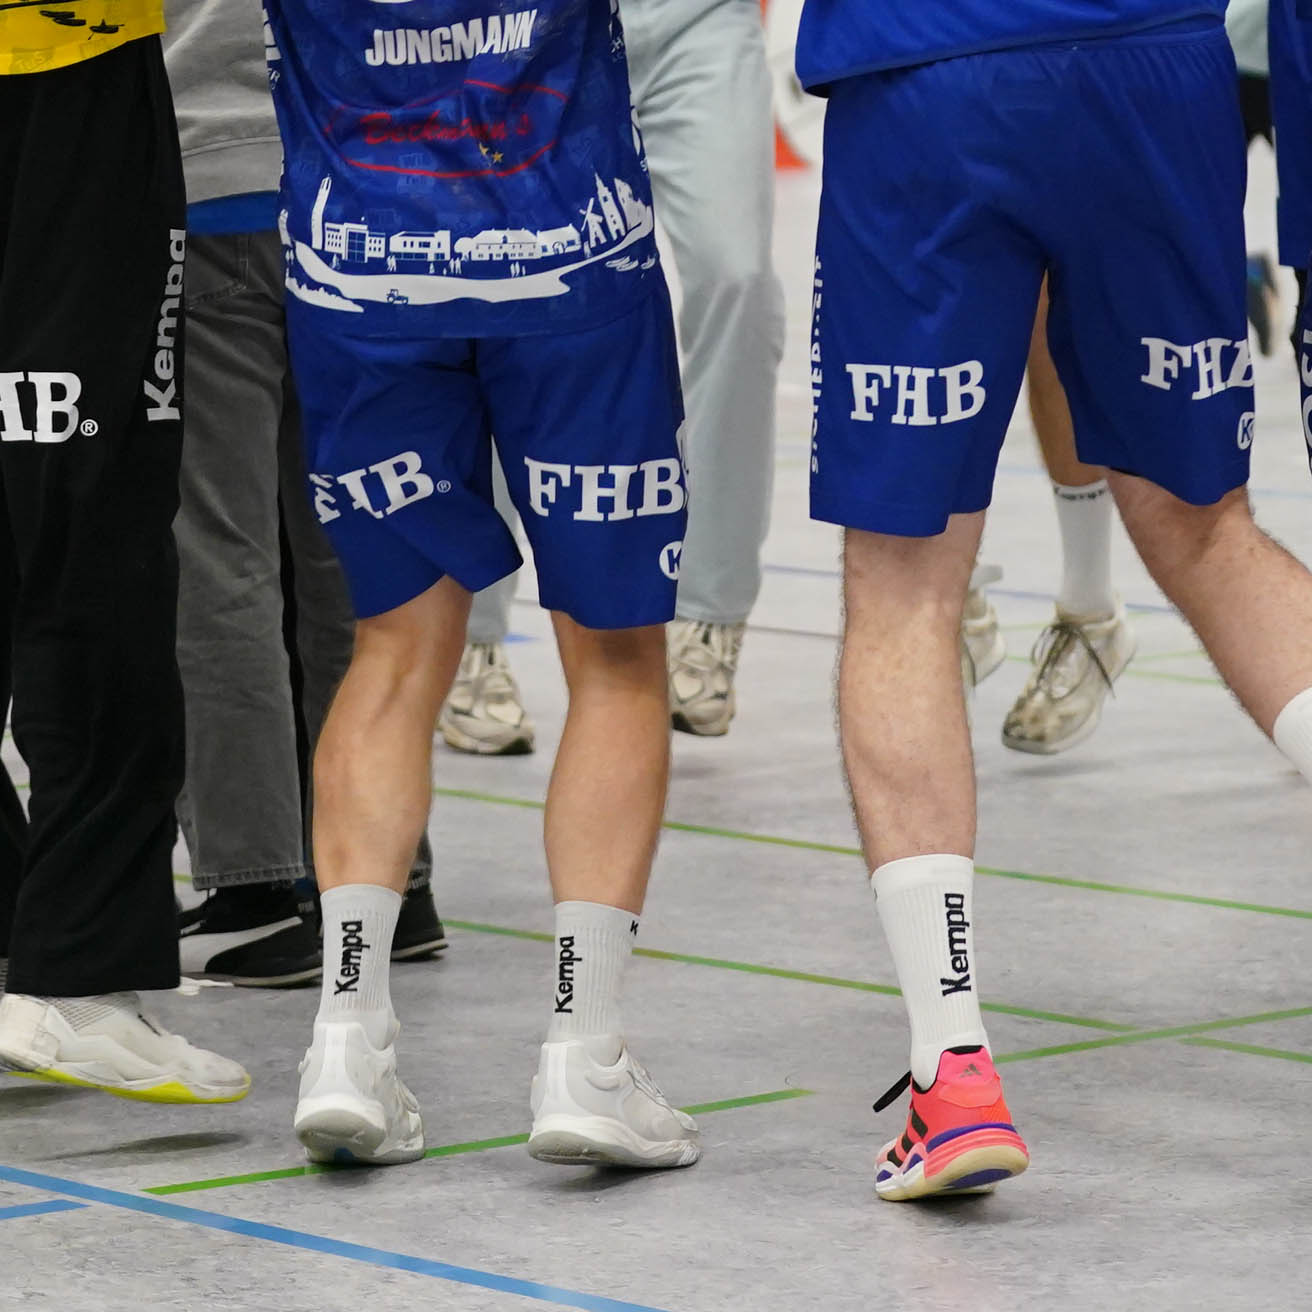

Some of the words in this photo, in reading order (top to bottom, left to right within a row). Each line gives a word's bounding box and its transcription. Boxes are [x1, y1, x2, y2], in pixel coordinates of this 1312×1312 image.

[365, 9, 539, 67] JUNGMANN
[143, 228, 187, 422] Kempa
[845, 360, 986, 427] FHB
[523, 456, 687, 522] FHB
[334, 919, 364, 996] Kempa
[555, 935, 575, 1015] Kempa
[941, 892, 972, 997] Kempa
